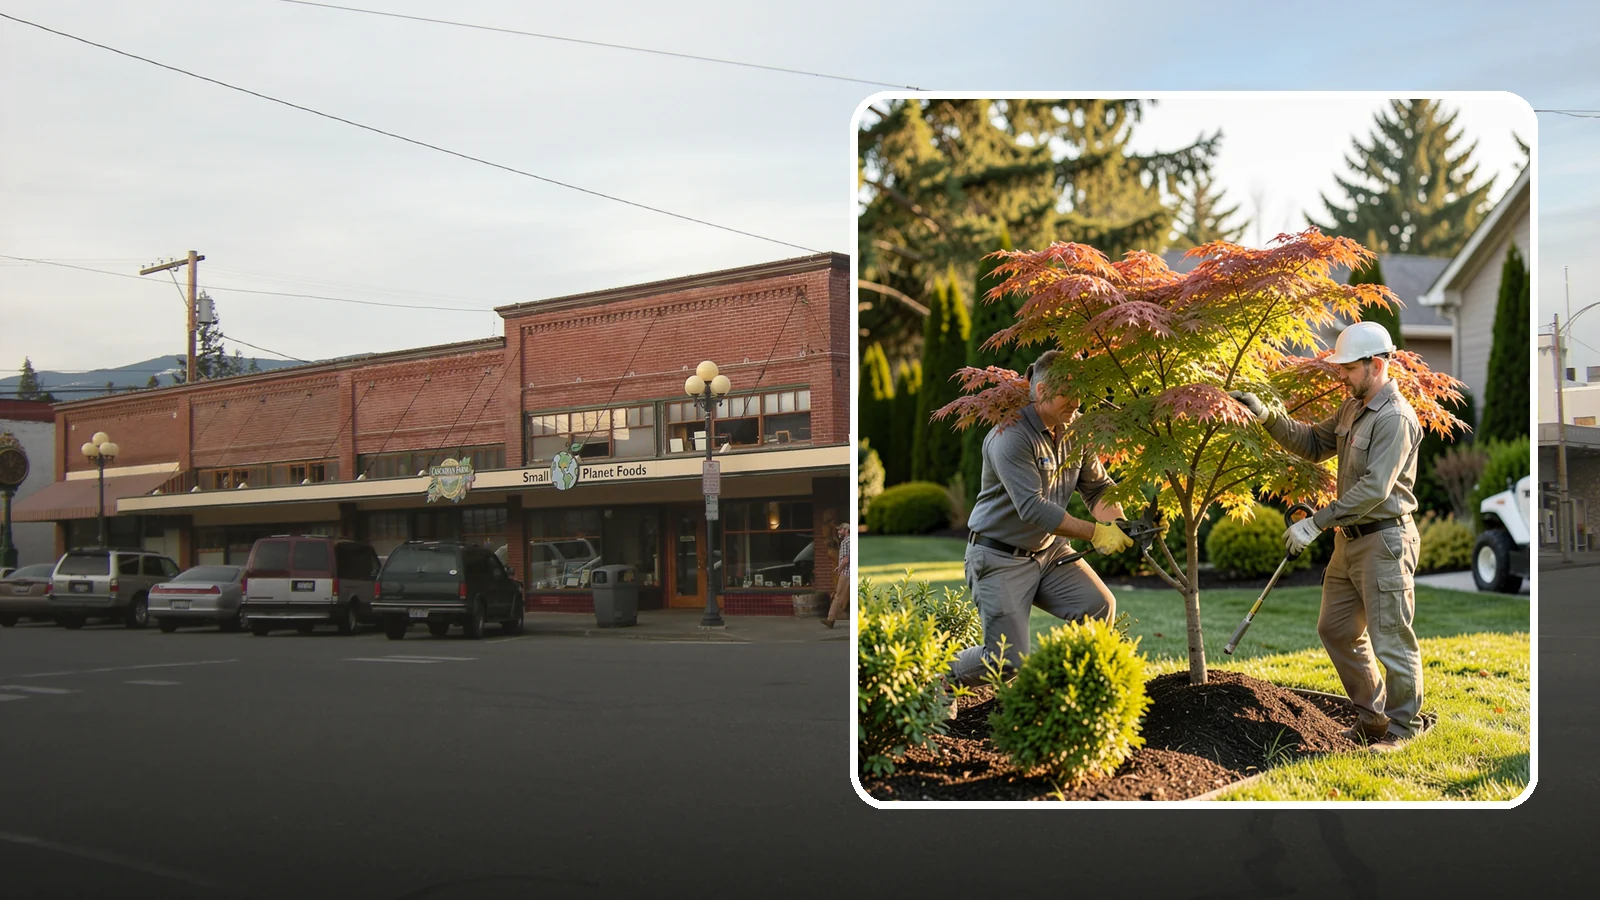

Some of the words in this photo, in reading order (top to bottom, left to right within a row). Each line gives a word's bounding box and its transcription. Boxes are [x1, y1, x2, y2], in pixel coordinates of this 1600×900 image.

[523, 470, 549, 483] Small
[583, 468, 614, 479] Planet
[617, 464, 647, 477] Foods
